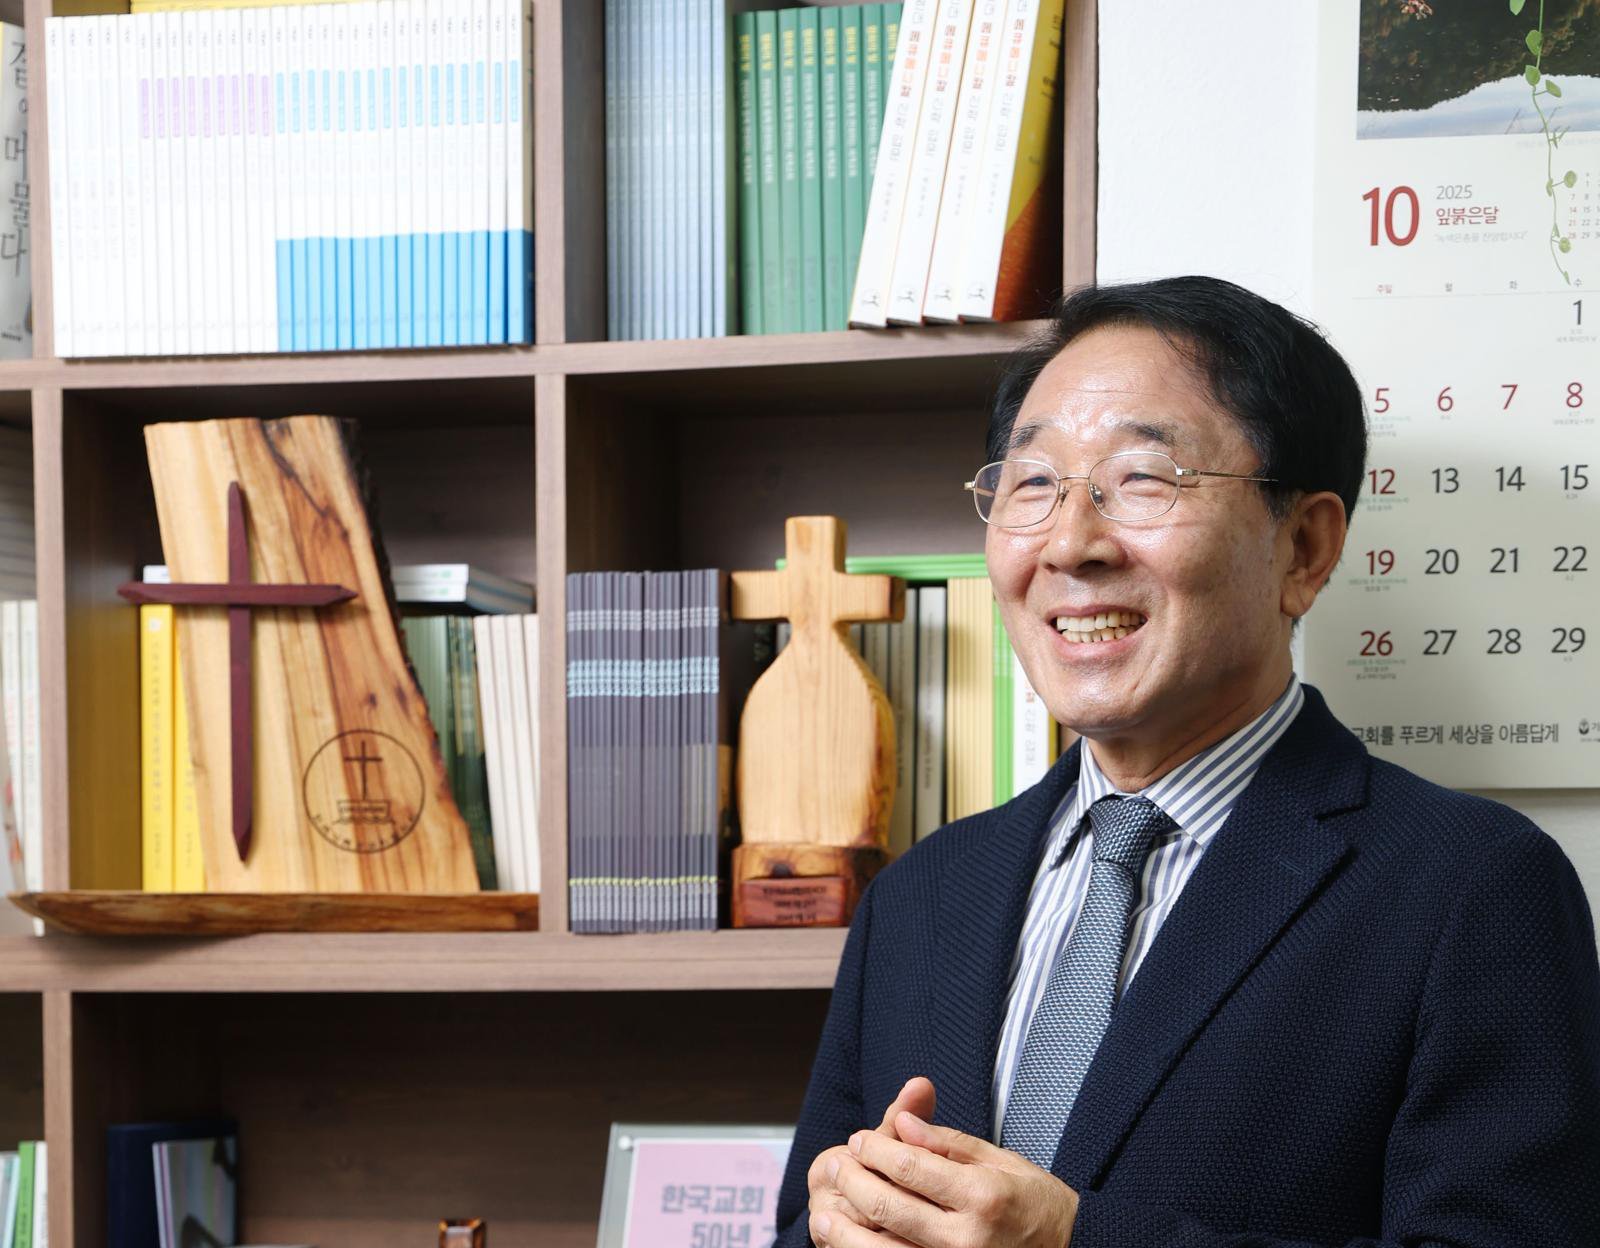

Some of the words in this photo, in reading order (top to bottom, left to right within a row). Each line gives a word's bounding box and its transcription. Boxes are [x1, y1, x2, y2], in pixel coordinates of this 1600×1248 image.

[1436, 184, 1473, 200] 2025
[1362, 185, 1420, 247] 10
[1436, 205, 1499, 226] 잎붉은달
[1572, 299, 1583, 326] 1
[1374, 388, 1390, 413] 5
[1438, 387, 1454, 412] 6
[1501, 384, 1519, 410] 7
[1566, 382, 1583, 409] 8
[1367, 468, 1396, 495] 12
[1431, 467, 1460, 494] 13
[1495, 465, 1526, 492] 14
[1560, 464, 1589, 491] 15
[1366, 549, 1395, 576] 19
[1424, 548, 1459, 575] 20
[1490, 547, 1519, 573] 21
[1553, 545, 1588, 572] 22
[1360, 630, 1393, 657] 26
[1423, 629, 1457, 655] 27
[1486, 628, 1521, 654] 28
[1551, 627, 1586, 653] 29
[1399, 724, 1444, 744] 푸르게
[1449, 724, 1494, 745] 세상을
[1498, 723, 1559, 744] 아름답게
[661, 1184, 764, 1215] 한국교회
